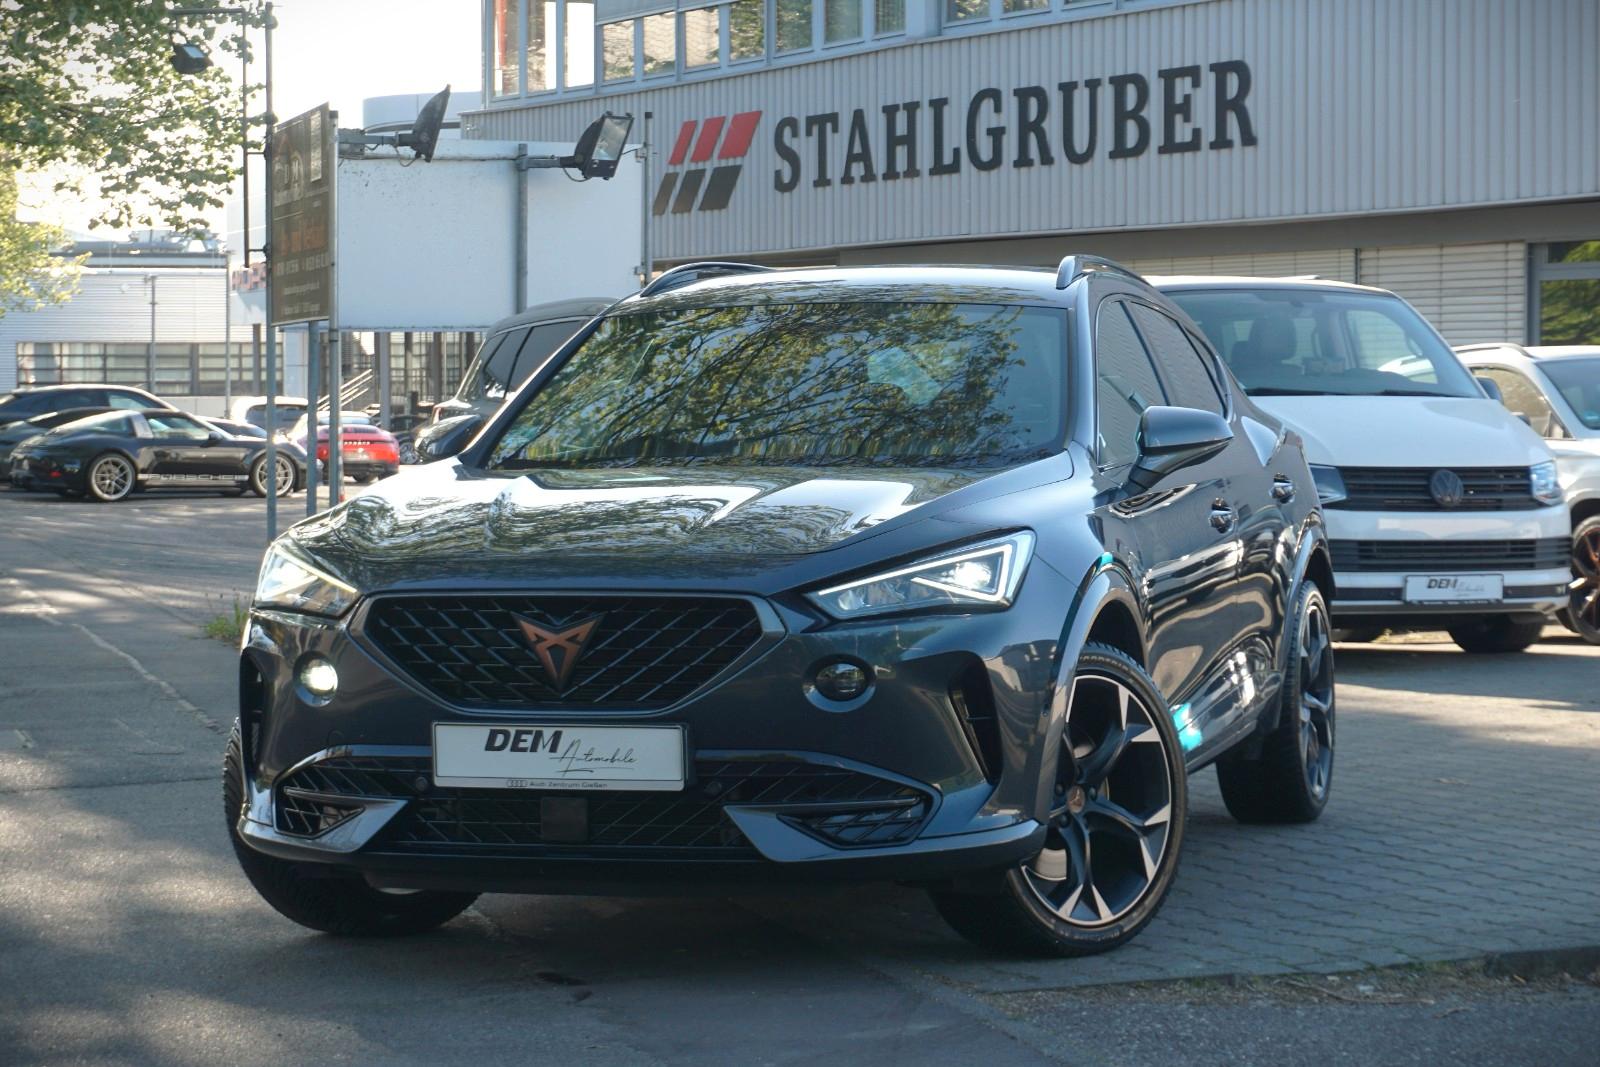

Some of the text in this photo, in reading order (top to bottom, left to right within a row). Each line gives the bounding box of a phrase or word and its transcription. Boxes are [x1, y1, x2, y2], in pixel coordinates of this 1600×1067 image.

[773, 59, 1257, 193] STAHLGRUBER
[1427, 578, 1458, 589] DEM
[484, 728, 563, 753] DEM
